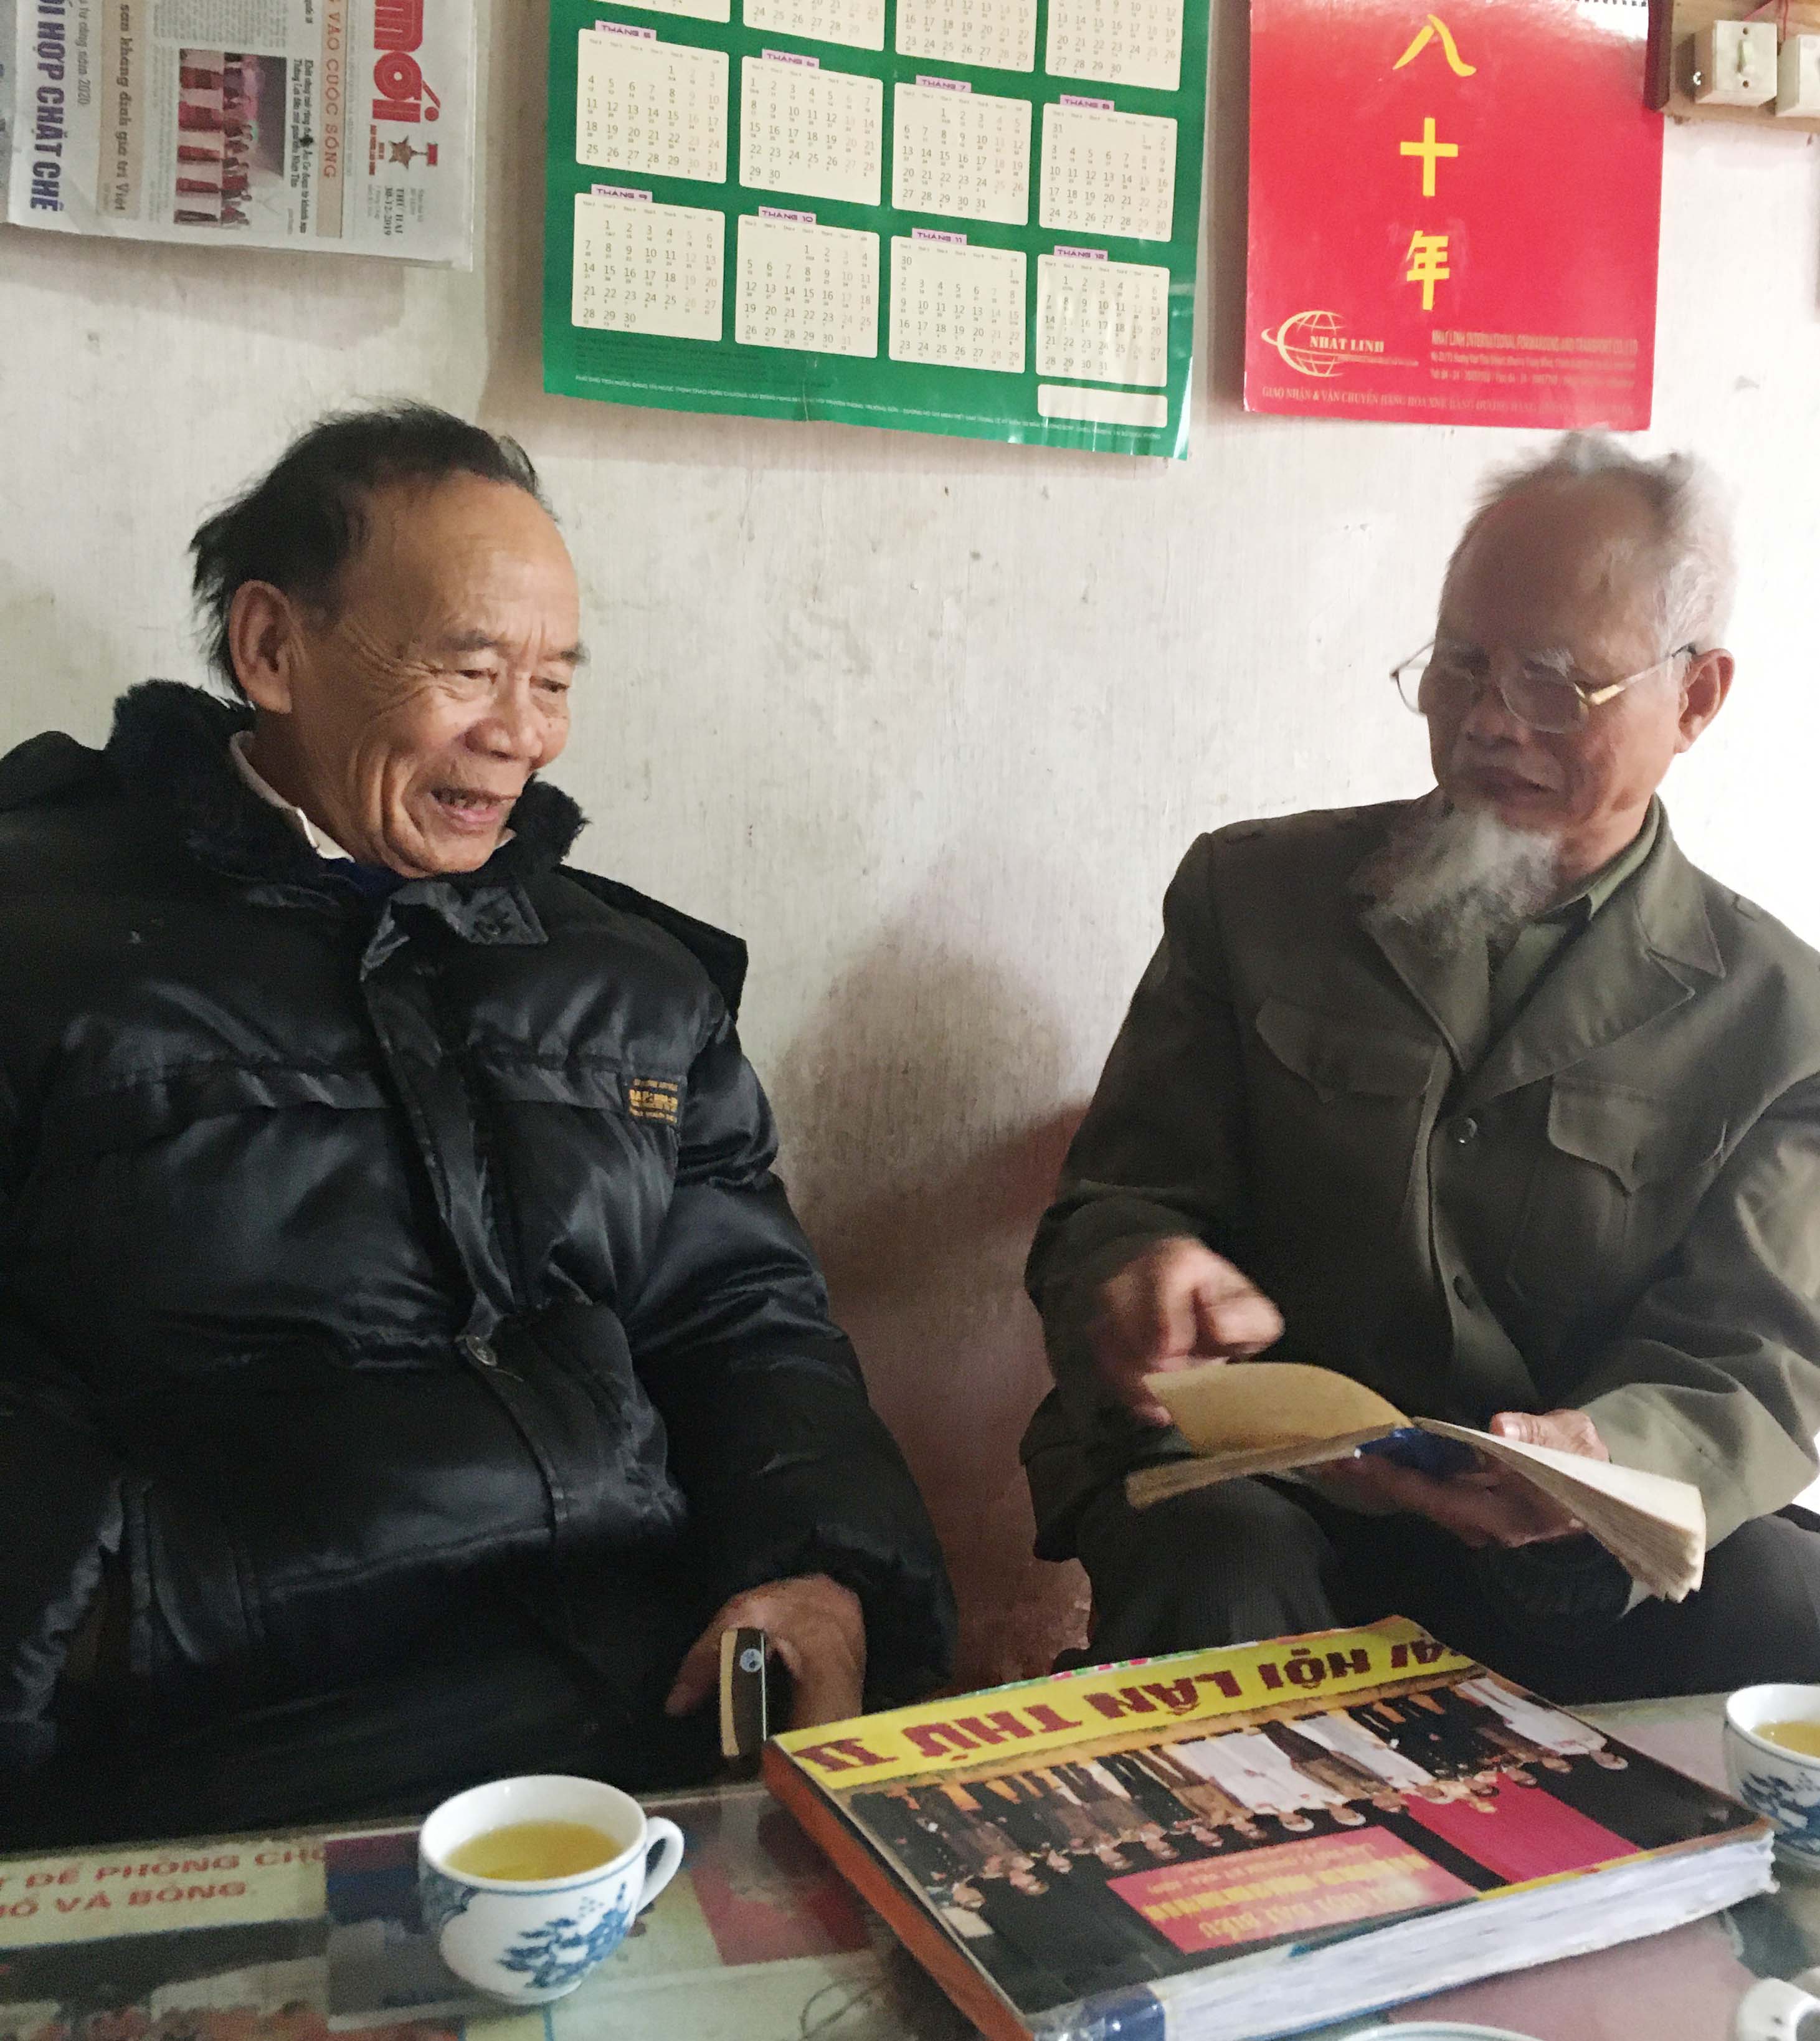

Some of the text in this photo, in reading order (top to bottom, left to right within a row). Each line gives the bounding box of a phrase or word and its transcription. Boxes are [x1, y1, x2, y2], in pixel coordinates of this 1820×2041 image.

[668, 65, 673, 74] 1
[78, 78, 90, 105] 2020
[587, 75, 676, 98] 4 6 8
[808, 87, 815, 97] 4
[627, 103, 659, 117] 13 14
[751, 99, 837, 123] 8 9 12
[585, 120, 597, 131] 18
[749, 121, 837, 144] 15 16 18 19
[904, 125, 965, 142] 6 8 9
[585, 143, 680, 166] 25 26 28 29
[788, 150, 838, 166] 24 26
[902, 145, 969, 163] 13 14 15 16
[1051, 144, 1112, 159] 3 4 6
[749, 165, 761, 176] 29
[1049, 165, 1132, 184] 10 11 12 13 14
[976, 176, 987, 187] 24
[902, 188, 986, 209] 27 29 31
[1066, 188, 1131, 205] 18 21
[1048, 207, 1060, 217] 24
[605, 219, 673, 237] 1 4
[605, 242, 676, 260] 8 9 11
[804, 244, 808, 254] 1
[583, 262, 676, 283] 14 15 16 18
[747, 259, 811, 276] 5 6 8
[746, 280, 833, 300] 12 13 14 15 16
[937, 281, 979, 295] 4 5 6
[1063, 275, 1123, 290] 1 4
[644, 292, 656, 302] 24
[1046, 294, 1126, 312] 7 8 9 10 11
[582, 307, 595, 318] 28
[744, 303, 777, 315] 19 20
[917, 300, 946, 312] 10 11
[899, 318, 965, 335] 16 17 18 19
[1045, 314, 1125, 332] 14 17 18
[917, 341, 965, 356] 24 26
[1350, 340, 1385, 353] LINH
[1045, 356, 1056, 365] 28
[1258, 1648, 1372, 1690] HỘI
[1083, 1670, 1243, 1720] LẦN
[902, 1704, 1083, 1762] THỨ
[793, 1737, 898, 1773] II
